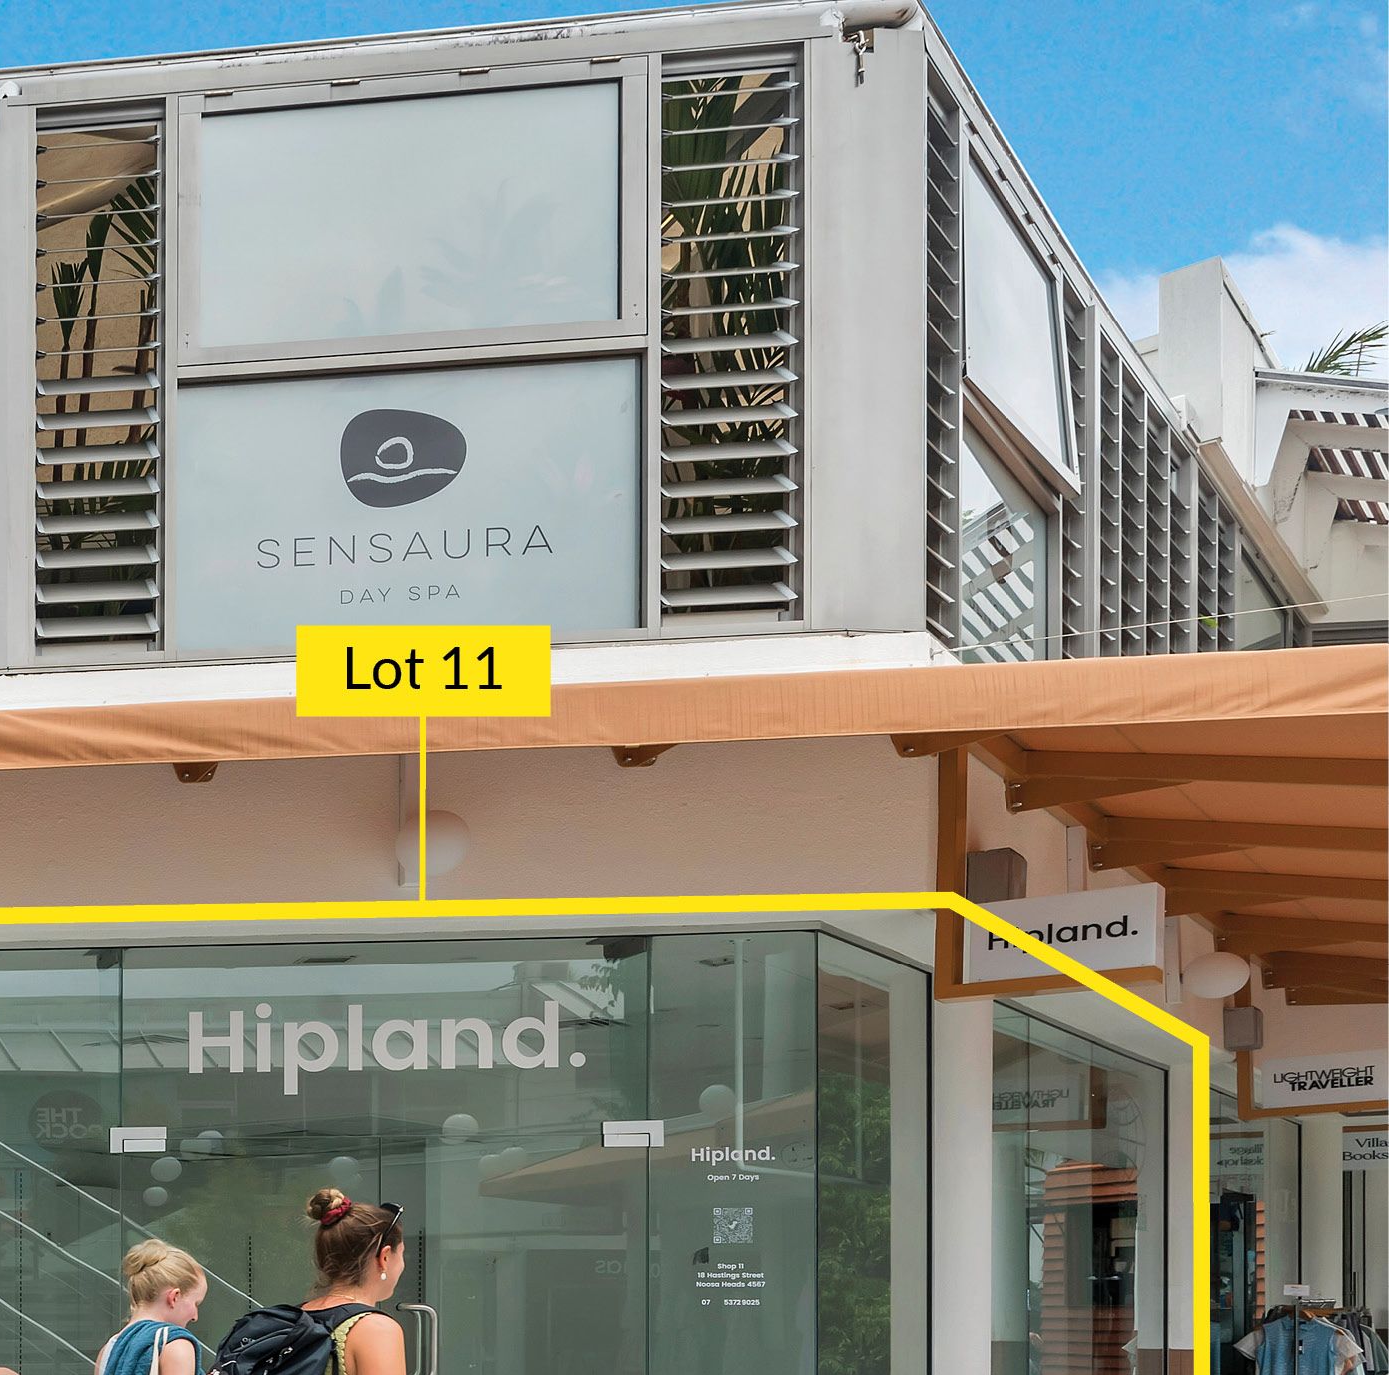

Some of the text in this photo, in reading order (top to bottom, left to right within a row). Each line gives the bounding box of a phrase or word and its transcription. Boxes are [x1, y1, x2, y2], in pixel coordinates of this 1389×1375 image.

[256, 524, 554, 569] SENSAURA
[339, 584, 461, 605] DAY SPA
[187, 1000, 588, 1096] Hipland.
[1273, 1065, 1375, 1084] LIGHTWEIGHT
[1289, 1076, 1374, 1092] TRAVELLER
[691, 1146, 776, 1167] Hipland.
[707, 1174, 730, 1182] Open
[738, 1174, 760, 1182] Days
[707, 1272, 740, 1280] Hastings
[717, 1263, 737, 1271] Shop
